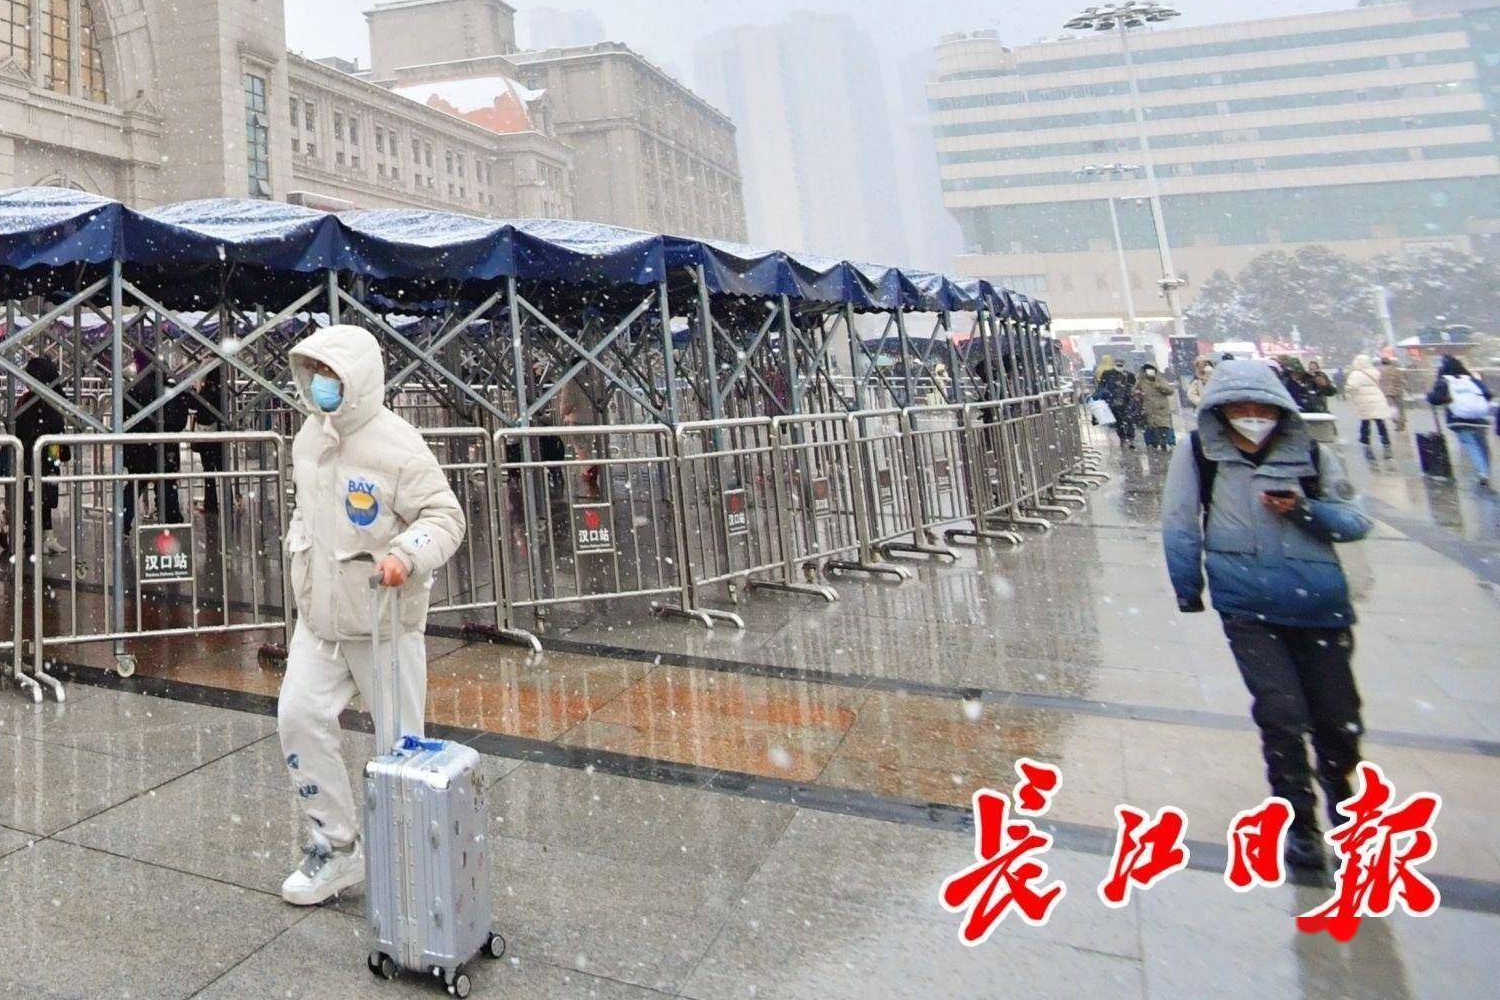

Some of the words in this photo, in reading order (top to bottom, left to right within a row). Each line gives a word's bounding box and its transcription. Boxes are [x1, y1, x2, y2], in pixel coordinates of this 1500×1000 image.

[348, 480, 375, 493] BAY
[145, 552, 188, 571] 汉口站
